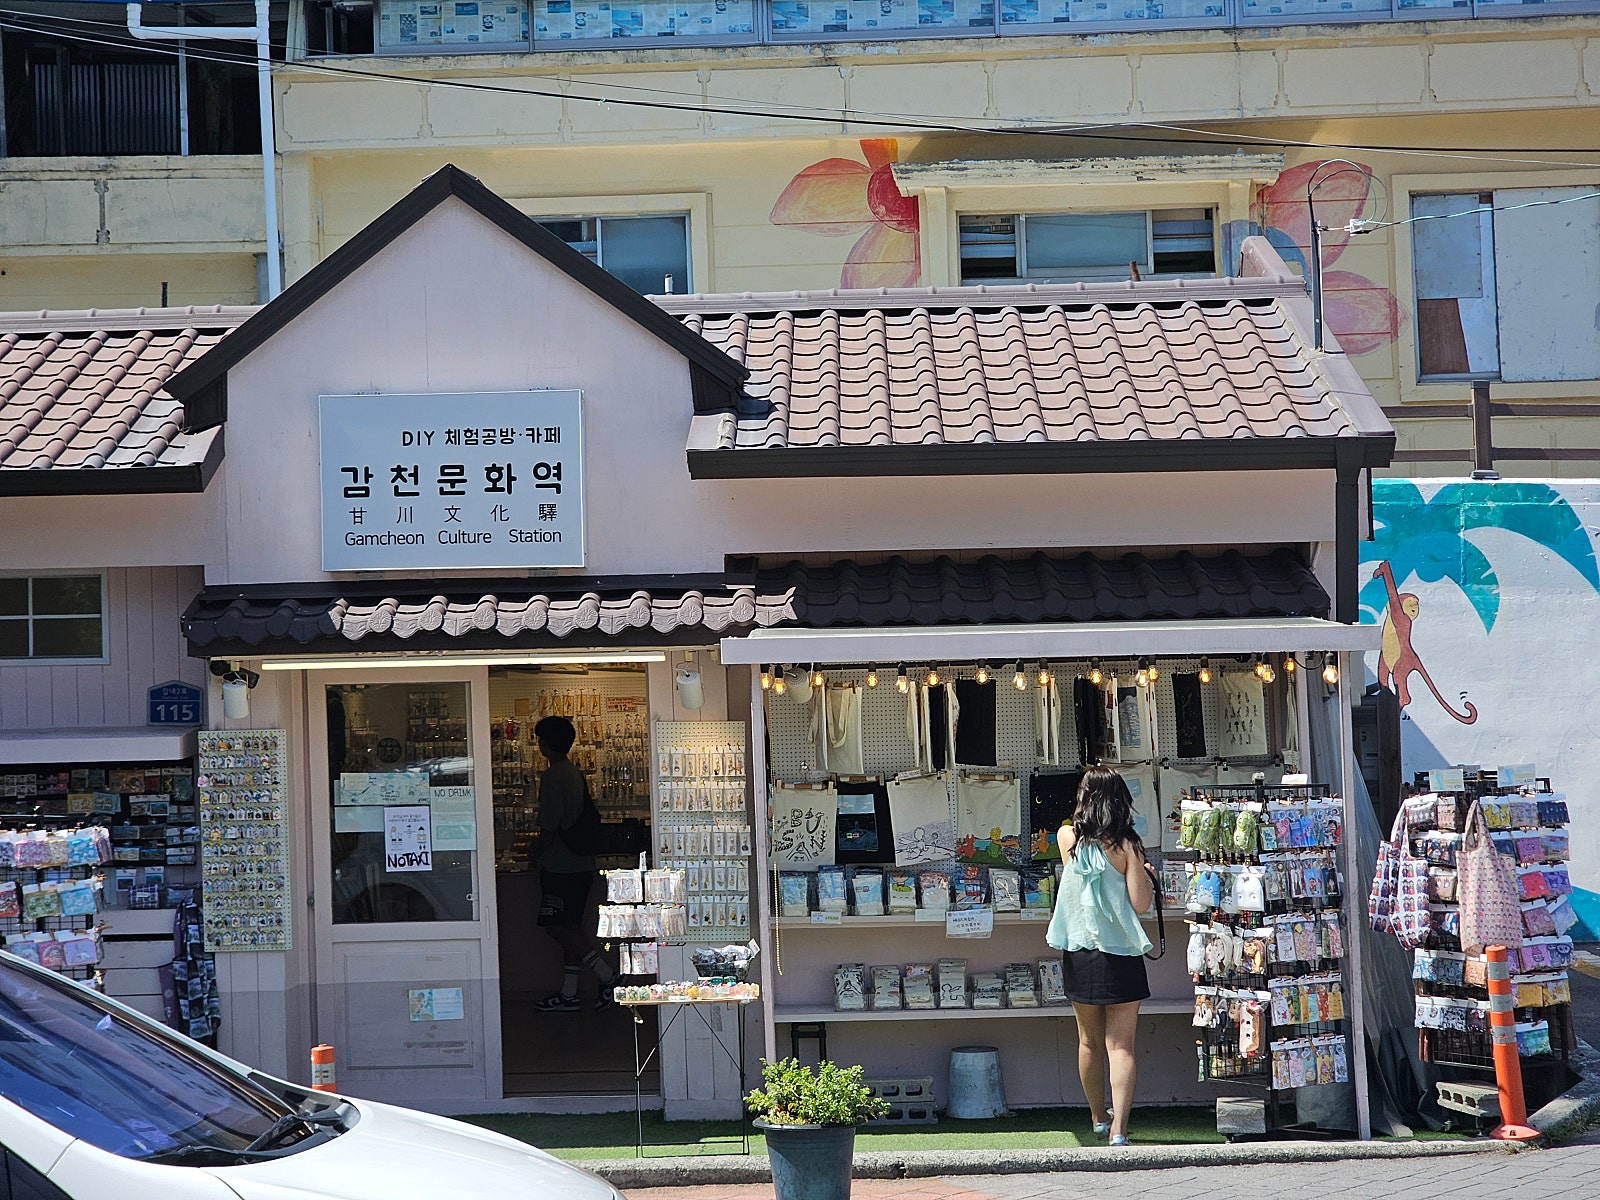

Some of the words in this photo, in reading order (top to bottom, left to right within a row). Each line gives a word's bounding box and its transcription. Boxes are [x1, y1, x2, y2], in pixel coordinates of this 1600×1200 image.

[402, 430, 435, 447] DIY
[344, 530, 425, 546] Gamcheon
[438, 530, 492, 545] Culture
[508, 528, 562, 543] Station
[156, 704, 194, 721] 115
[434, 789, 446, 798] NO
